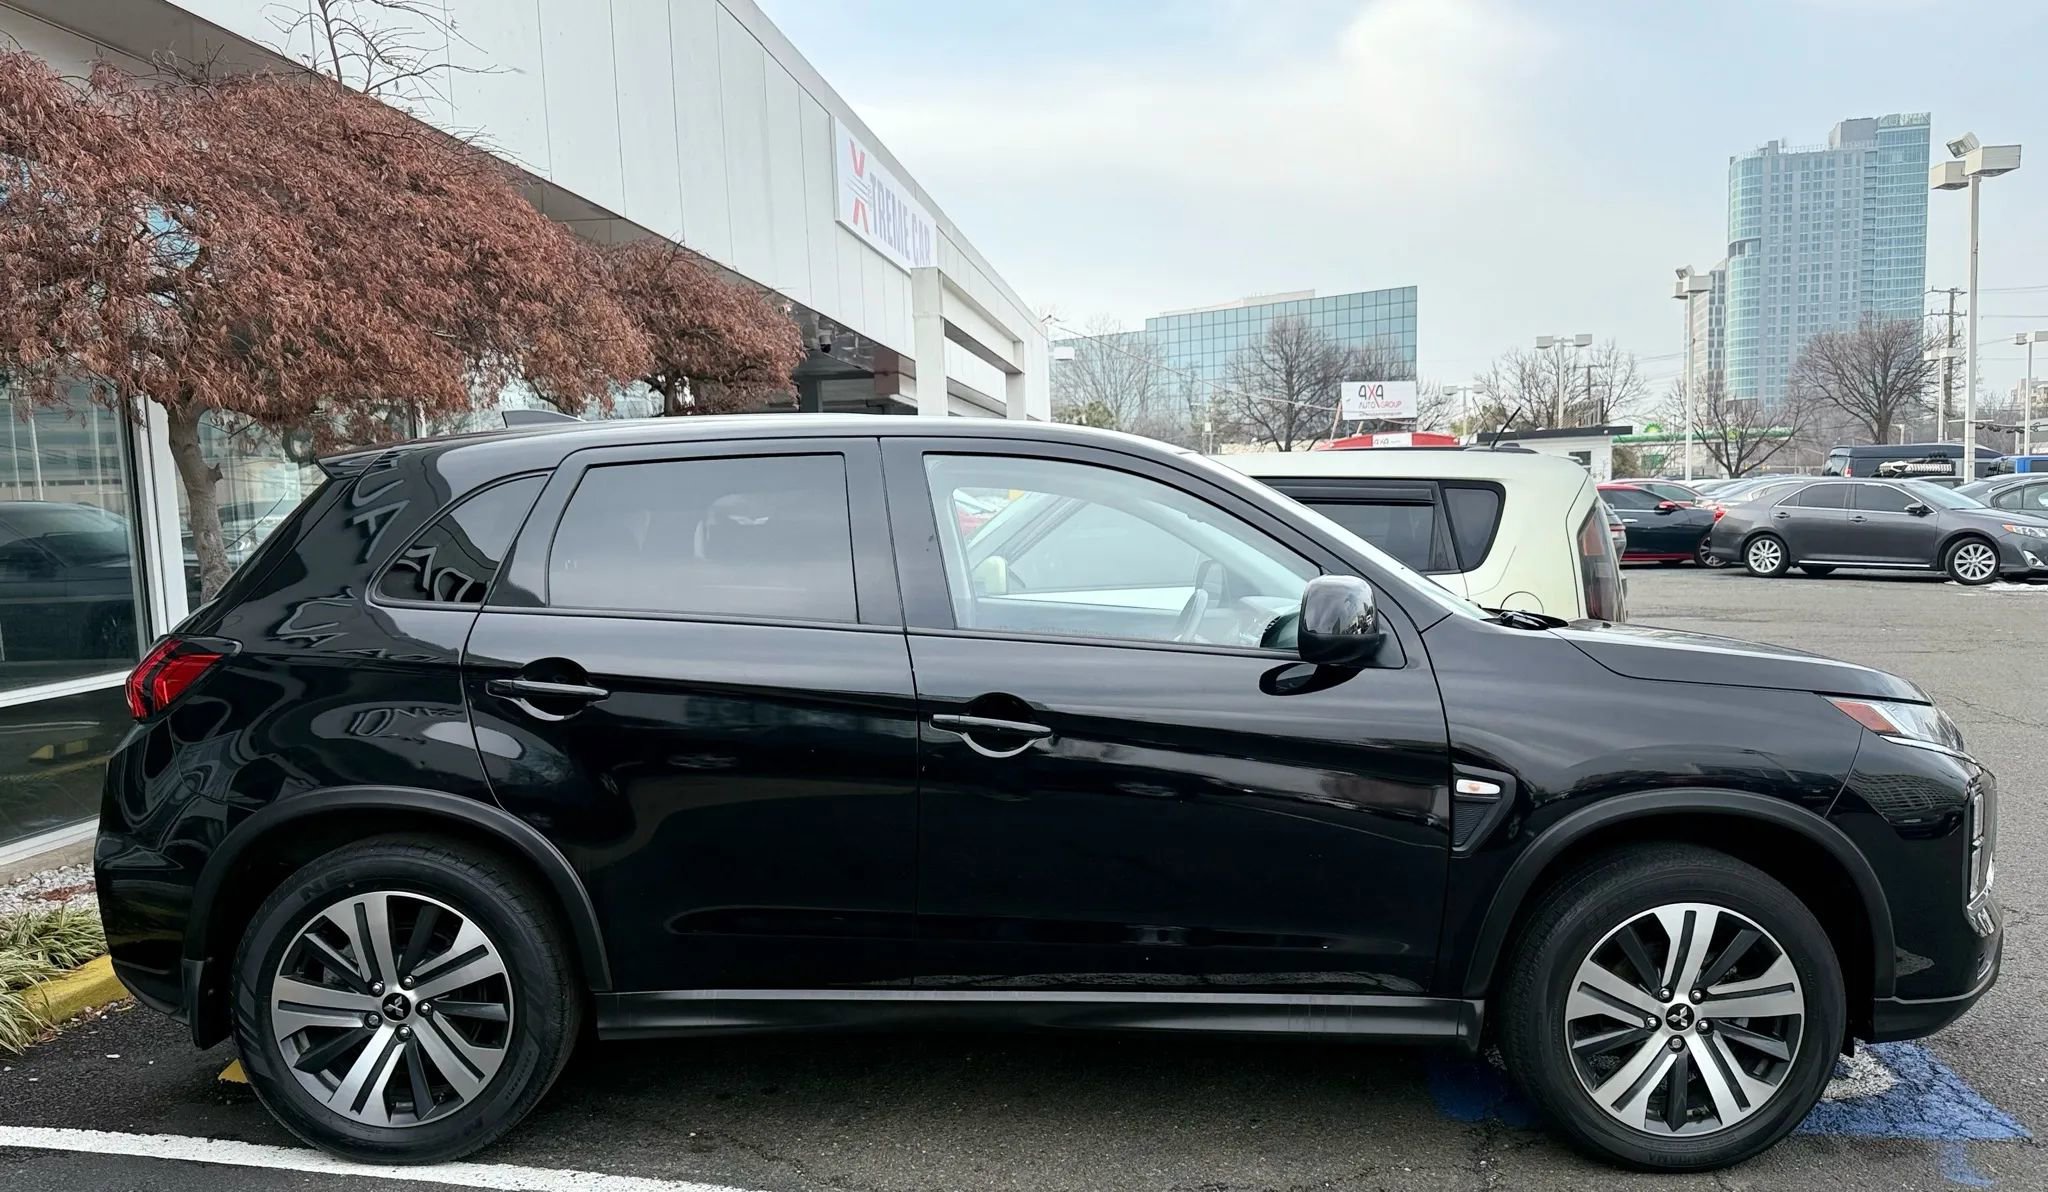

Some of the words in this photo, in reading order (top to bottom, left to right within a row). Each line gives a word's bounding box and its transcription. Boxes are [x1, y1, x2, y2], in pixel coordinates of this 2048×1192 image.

[912, 212, 931, 267] CAR
[1358, 401, 1376, 409] AUTO
[1380, 400, 1402, 409] GROUP
